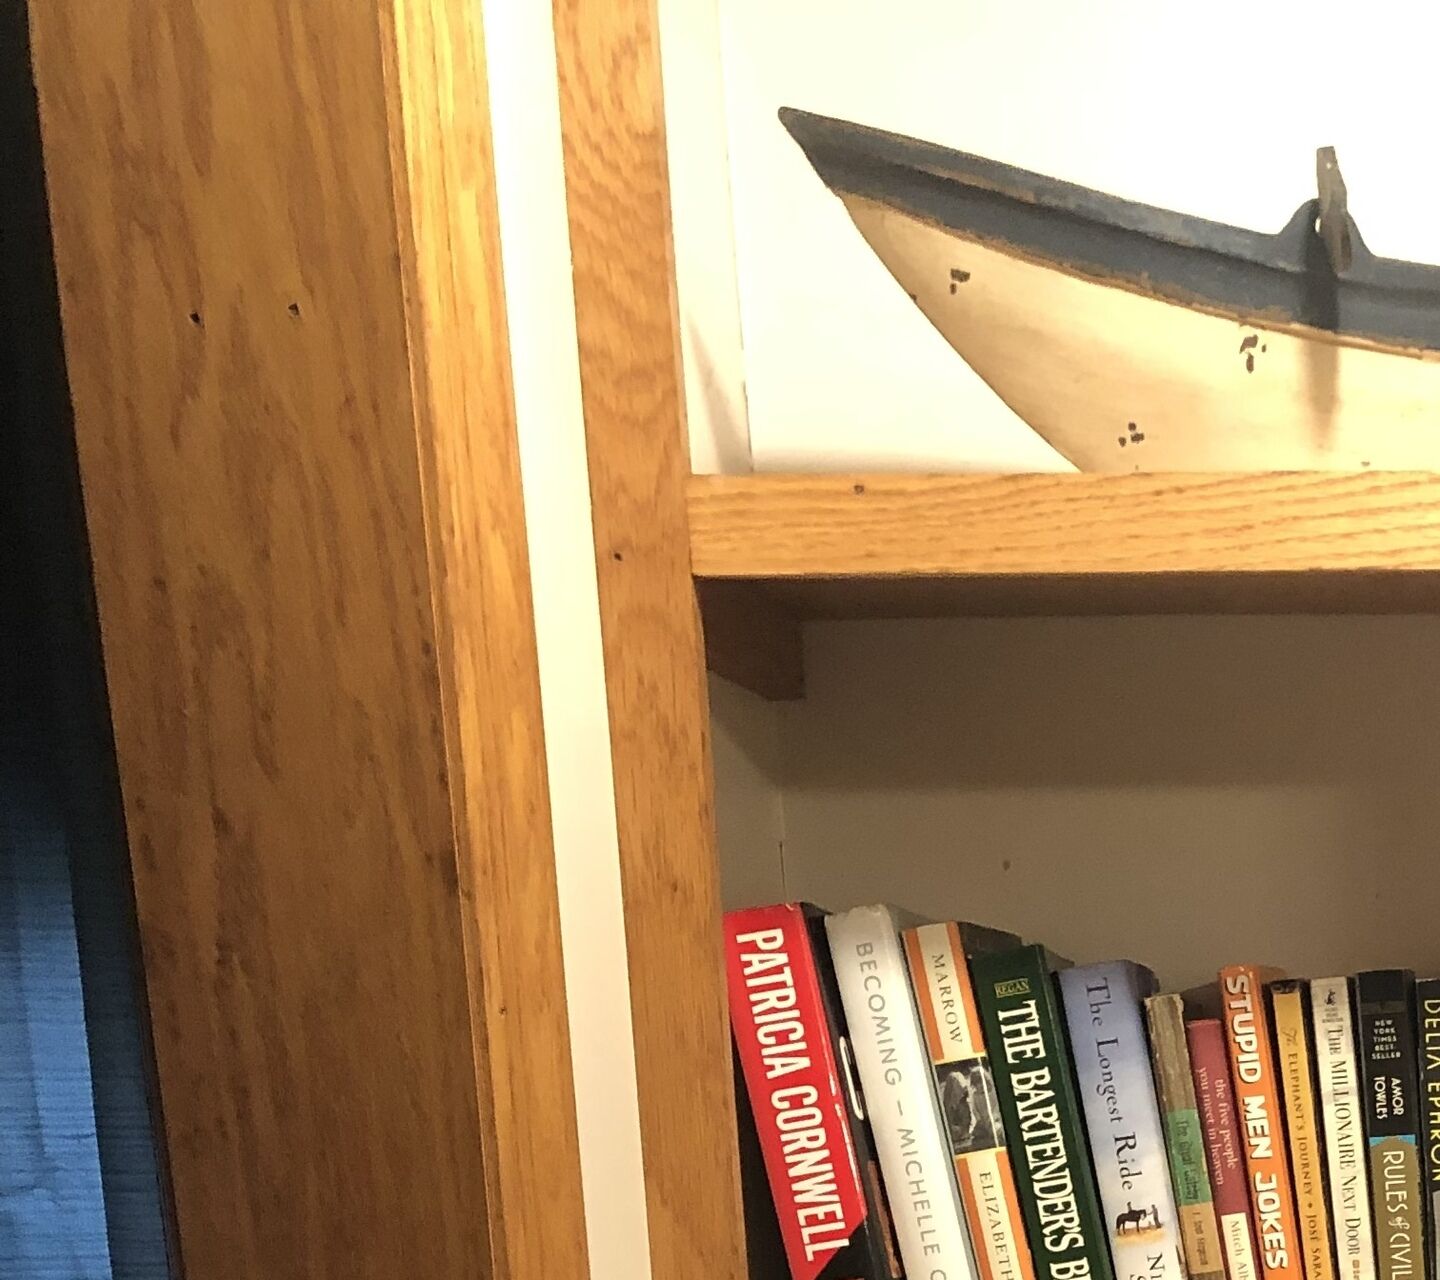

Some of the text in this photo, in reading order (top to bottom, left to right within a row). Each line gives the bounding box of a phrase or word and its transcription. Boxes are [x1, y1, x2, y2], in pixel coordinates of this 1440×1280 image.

[932, 953, 963, 1044] MARROW
[997, 1000, 1047, 1064] THE
[1328, 1023, 1344, 1057] THE
[735, 928, 849, 1262] PATRICIA CORNWELL
[856, 942, 902, 1086] BECOMING
[898, 1127, 941, 1257] MICHELLE
[1086, 976, 1143, 1191] The Longest Ride
[1288, 1052, 1306, 1132] ELEPHANT'S
[1330, 1060, 1357, 1171] MILLIONAIRE
[1372, 1076, 1389, 1120] TOWLES
[1390, 1077, 1404, 1117] AMOR
[1198, 1067, 1224, 1186] you heaven
[1214, 1079, 1238, 1169] the five people
[1225, 974, 1289, 1270] STUPID MEN JOKES
[1296, 1136, 1313, 1197] JOURNEY
[1341, 1175, 1358, 1212] NEXT
[1382, 1150, 1408, 1214] RULES
[1230, 1219, 1245, 1254] Mitch
[1344, 1217, 1361, 1256] DOOR
